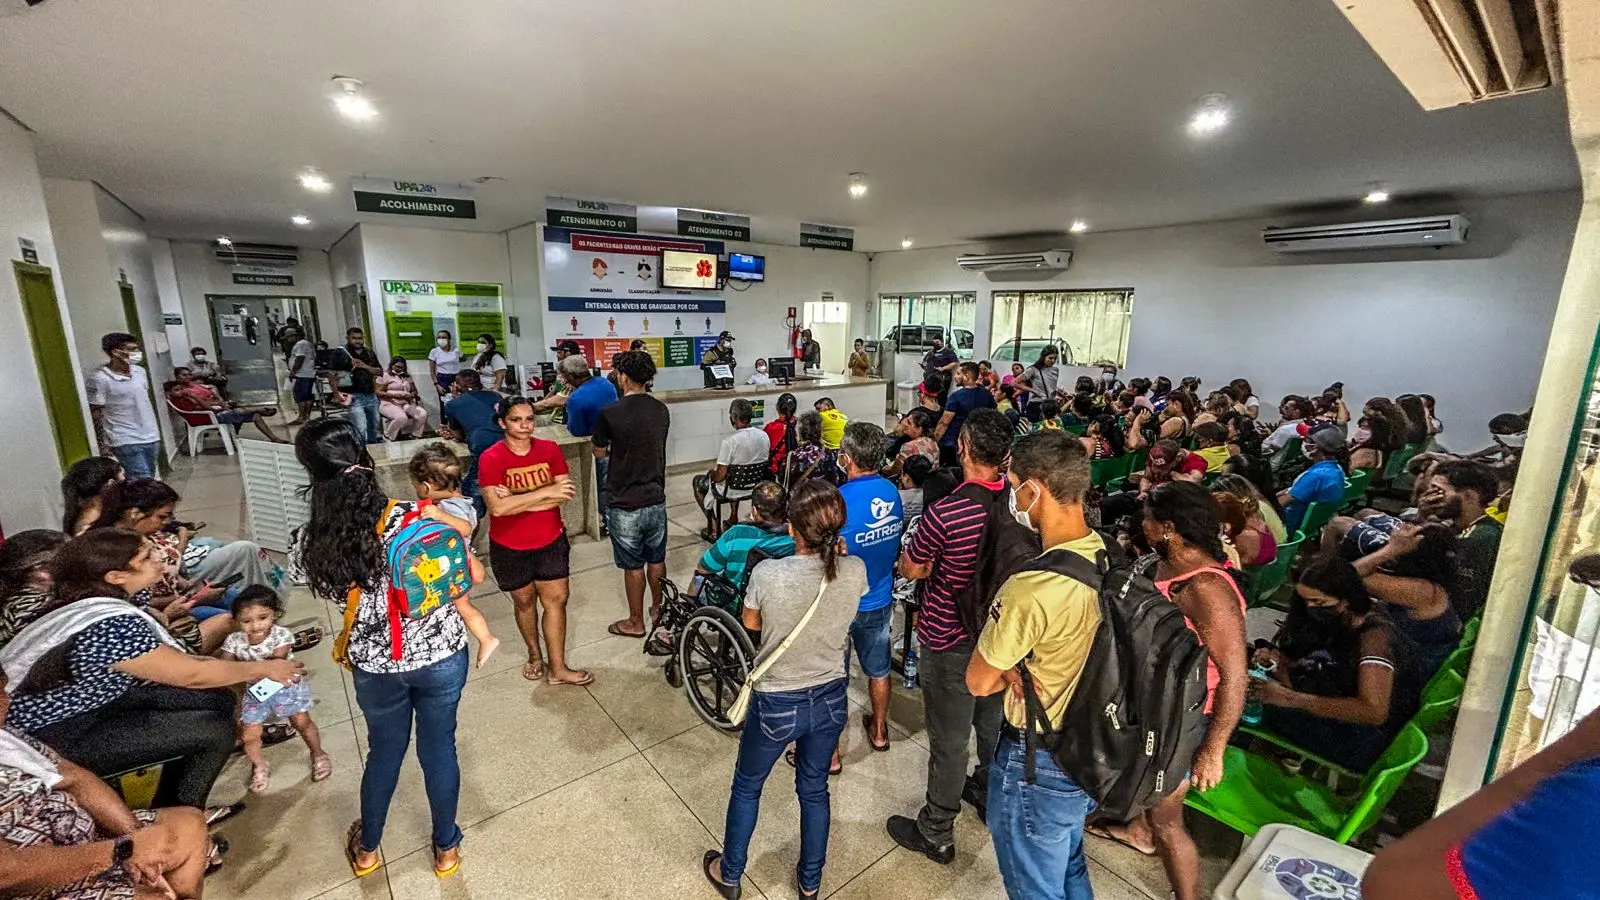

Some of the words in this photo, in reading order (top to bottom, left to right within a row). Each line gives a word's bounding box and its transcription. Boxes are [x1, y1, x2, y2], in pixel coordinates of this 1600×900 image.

[380, 199, 455, 213] ACOLHIMENTO
[560, 215, 616, 227] ATENDIMENTO
[617, 220, 626, 228] 01
[688, 225, 733, 236] ATENDIMENTO
[734, 230, 743, 238] 02
[807, 238, 841, 247] ATENDIMENTO
[383, 281, 434, 293] UPA24h
[621, 301, 640, 310] NÍVEIS
